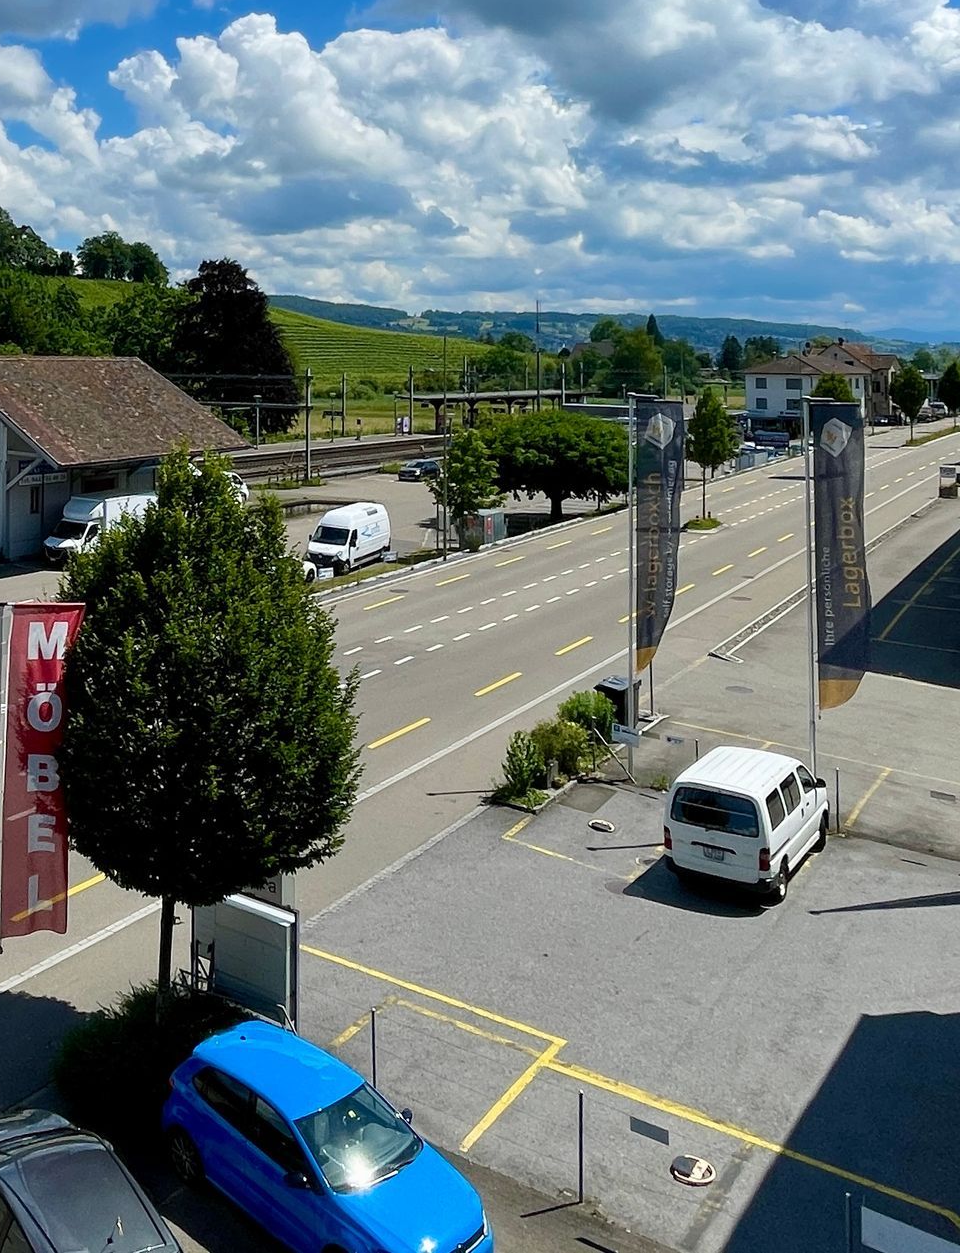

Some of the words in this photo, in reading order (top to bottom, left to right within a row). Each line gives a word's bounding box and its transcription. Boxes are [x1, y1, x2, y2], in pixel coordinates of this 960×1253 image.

[663, 542, 675, 554] by
[835, 496, 865, 609] Lagerbox
[664, 557, 675, 597] storage
[821, 546, 836, 618] persönliche
[823, 621, 836, 647] Ihre
[26, 621, 70, 915] MÖBEL
